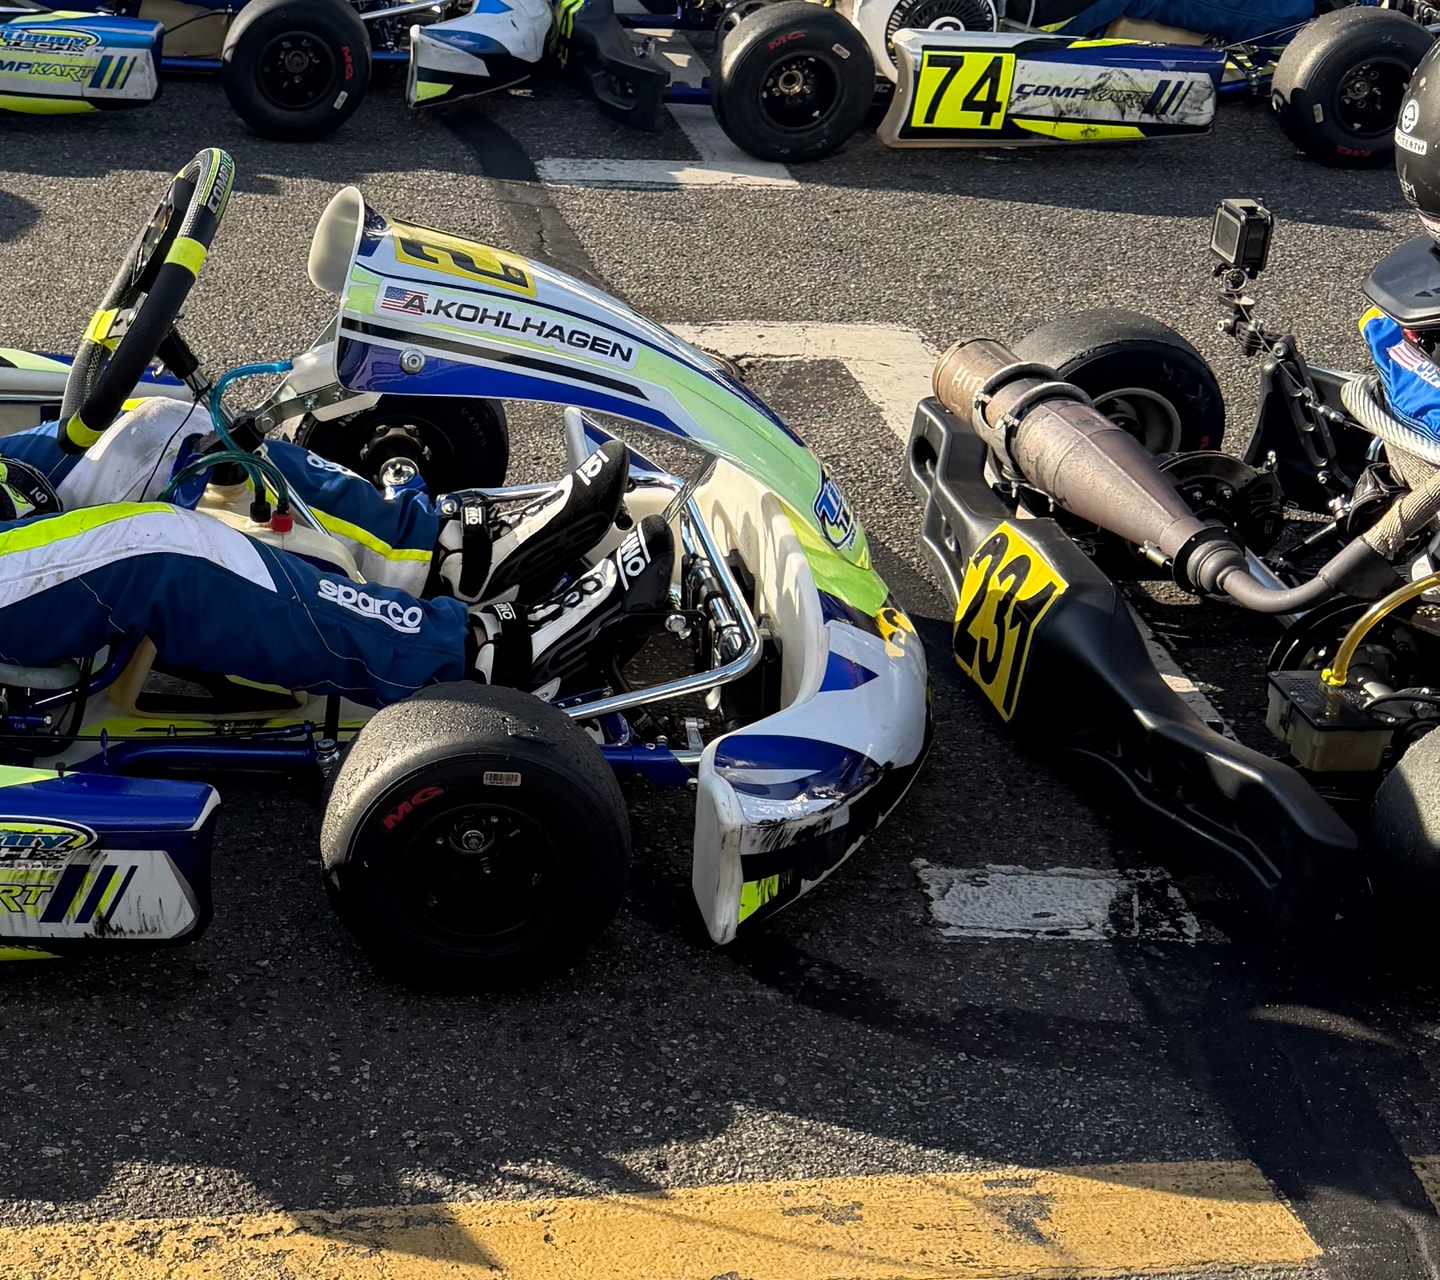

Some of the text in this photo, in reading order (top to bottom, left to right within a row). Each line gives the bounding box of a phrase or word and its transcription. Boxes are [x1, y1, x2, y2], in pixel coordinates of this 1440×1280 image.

[926, 55, 1003, 127] 74
[400, 294, 633, 363] A.KOHLHAGEN
[318, 579, 422, 634] sparco
[954, 531, 1059, 716] 231
[383, 784, 448, 830] MG
